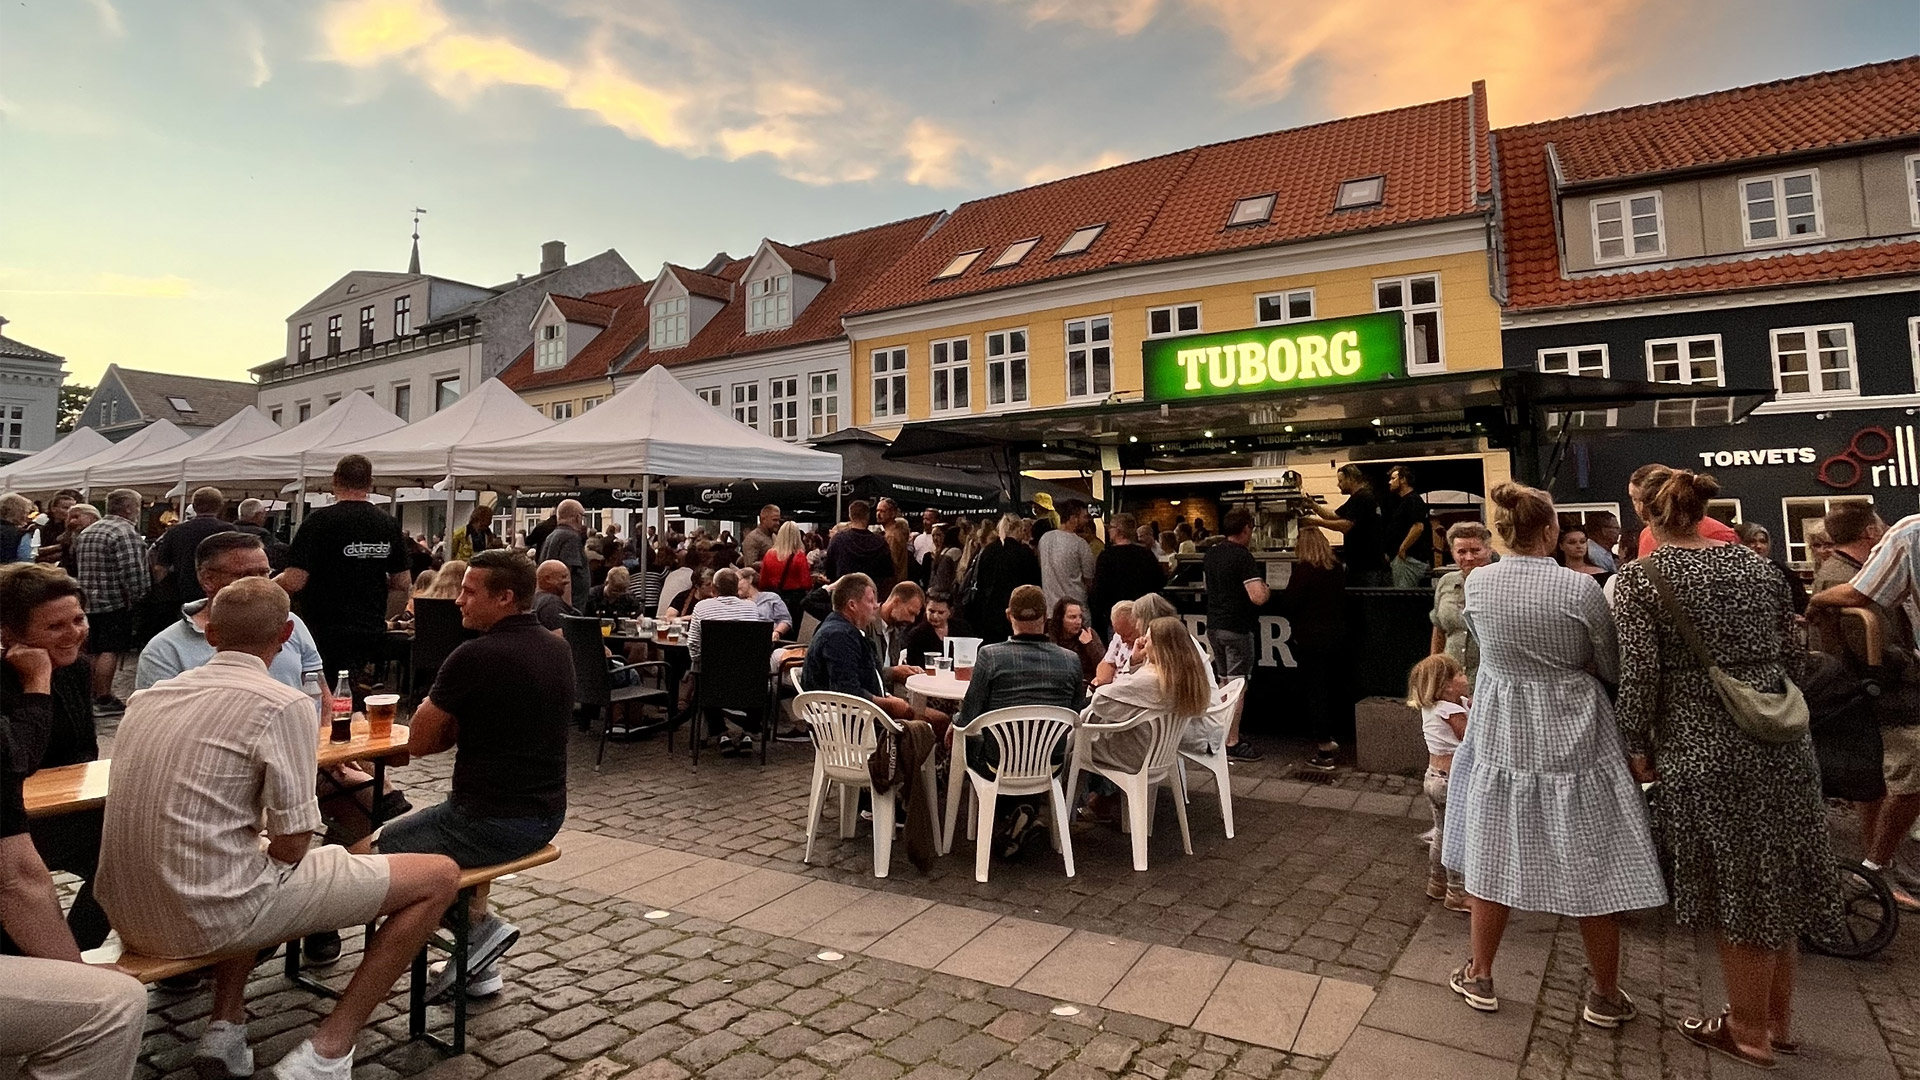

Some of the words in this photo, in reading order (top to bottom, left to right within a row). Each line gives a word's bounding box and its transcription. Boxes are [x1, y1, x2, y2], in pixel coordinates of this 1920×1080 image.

[1177, 330, 1361, 391] TUBORG
[1375, 425, 1414, 437] TUBORG
[1257, 434, 1291, 445] TUBORG
[1699, 447, 1817, 467] TORVETS
[701, 488, 733, 504] Carlsberg
